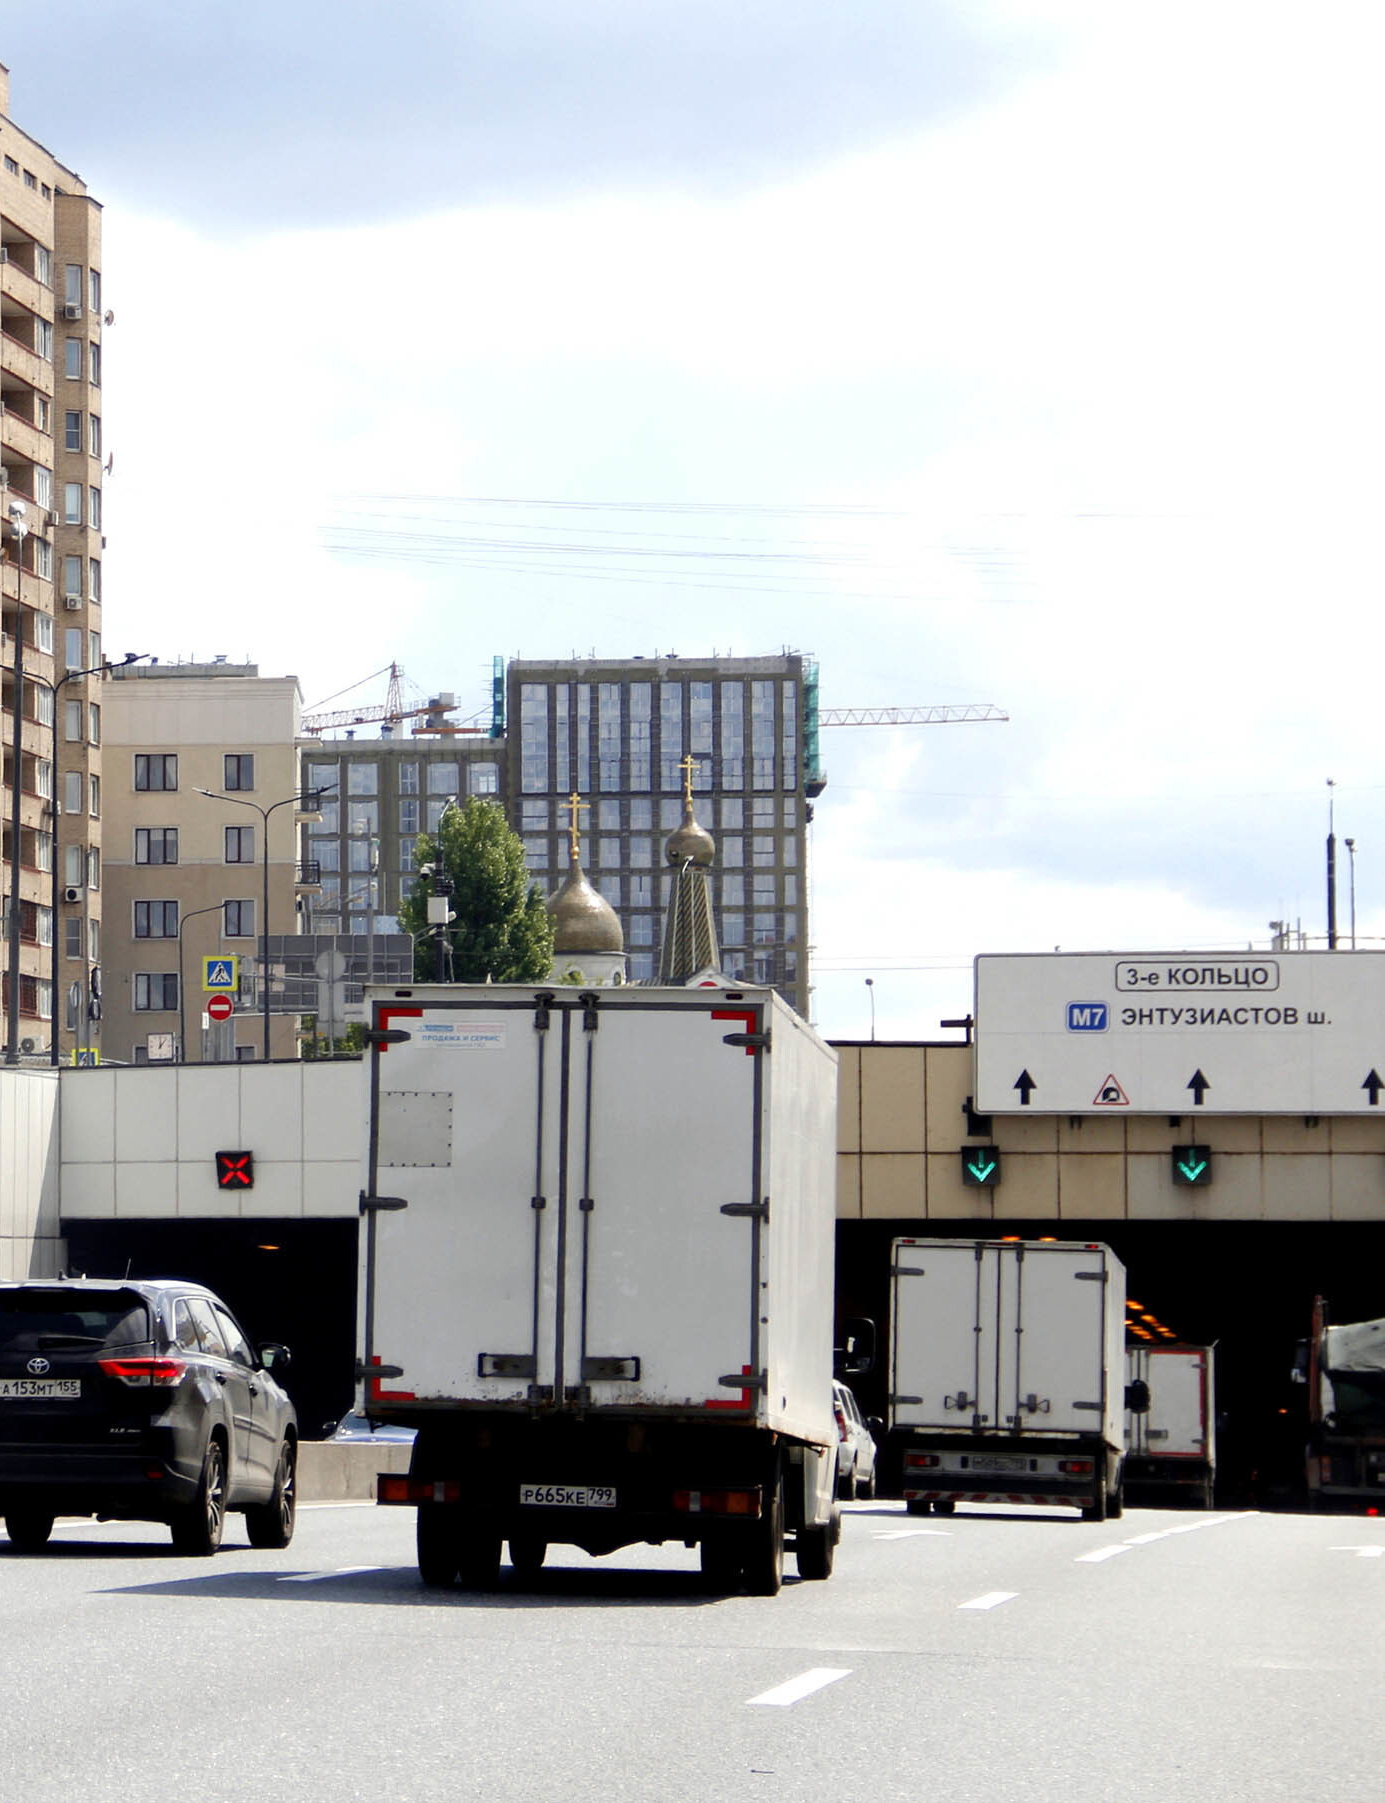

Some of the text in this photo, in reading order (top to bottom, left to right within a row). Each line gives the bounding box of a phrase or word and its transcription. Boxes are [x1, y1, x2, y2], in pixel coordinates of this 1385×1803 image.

[1126, 967, 1270, 988] 3-е КОЛЬЦО
[1071, 1008, 1104, 1027] М7
[1121, 1008, 1333, 1025] ЭНТУЗИАСТОВ ш.
